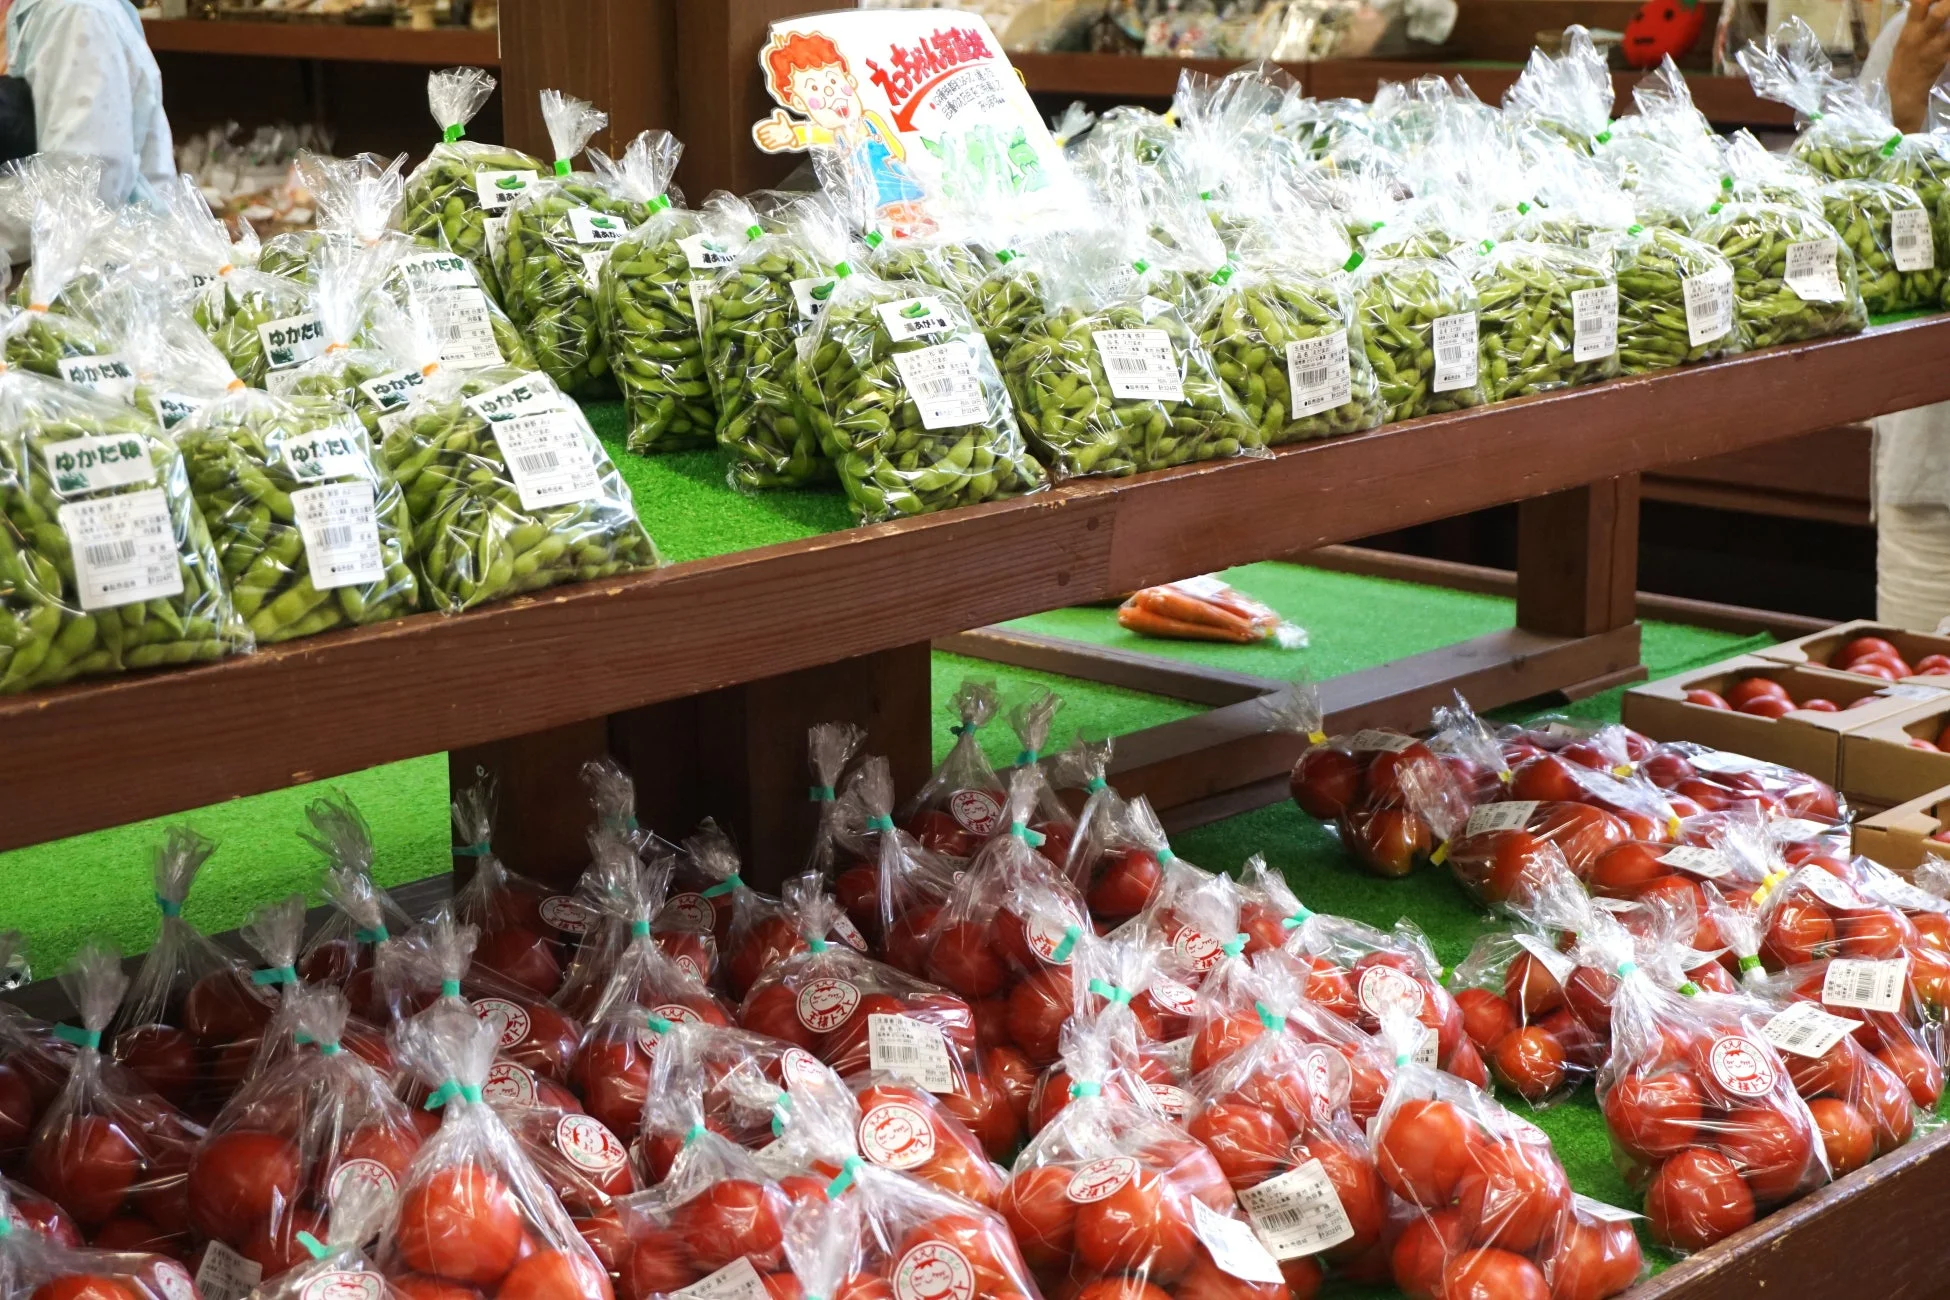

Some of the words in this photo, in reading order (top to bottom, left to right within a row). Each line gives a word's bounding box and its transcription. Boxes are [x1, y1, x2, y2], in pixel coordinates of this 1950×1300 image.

[55, 440, 143, 471] ゆかた娘
[806, 999, 853, 1028] 王様トマト
[1725, 1070, 1771, 1092] 王様トマト
